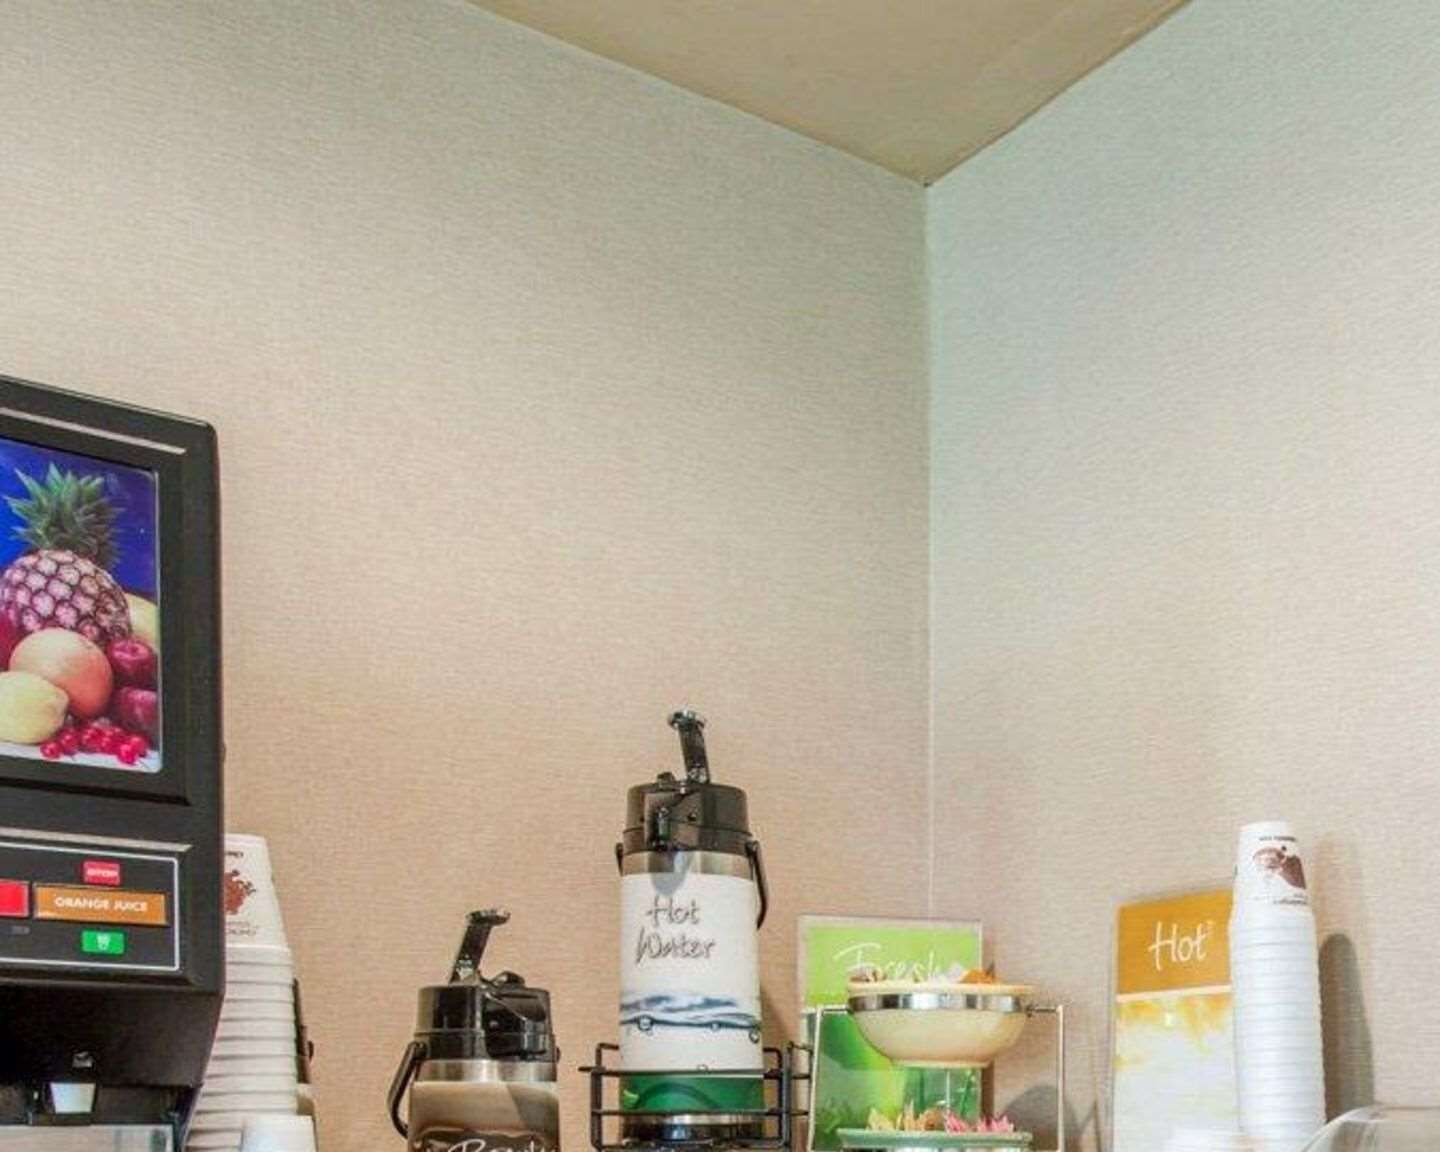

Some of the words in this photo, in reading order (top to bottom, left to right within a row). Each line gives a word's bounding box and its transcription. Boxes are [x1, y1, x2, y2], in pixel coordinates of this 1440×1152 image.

[55, 896, 110, 911] ORANGE
[113, 900, 149, 913] JUICE
[645, 895, 702, 928] Hot
[634, 926, 717, 965] Water
[1146, 920, 1208, 972] Hot
